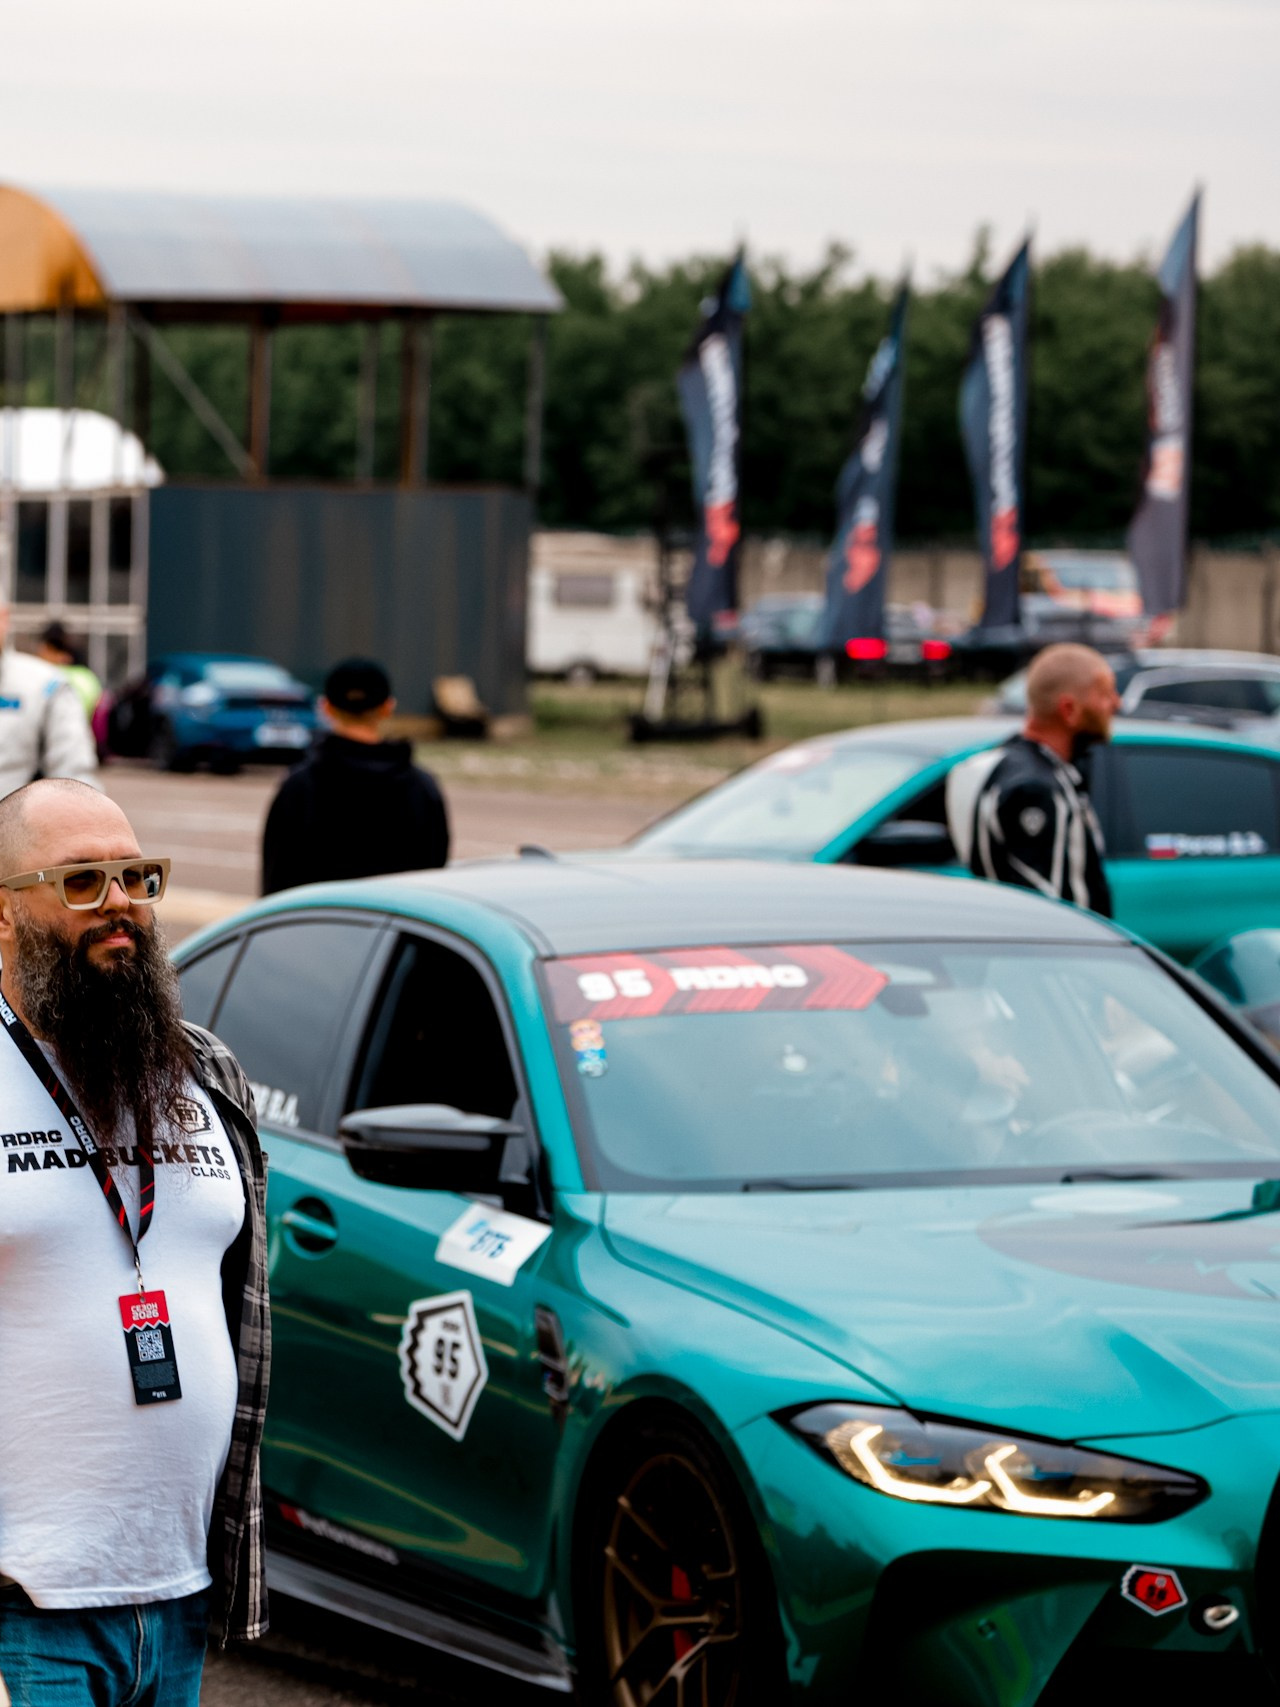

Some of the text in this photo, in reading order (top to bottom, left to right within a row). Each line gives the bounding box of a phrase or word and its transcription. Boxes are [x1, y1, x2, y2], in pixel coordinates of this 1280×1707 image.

[0, 1129, 63, 1148] RDRC
[70, 1115, 98, 1155] RDRC
[7, 1148, 88, 1173] MAD
[191, 1166, 231, 1180] CLASS
